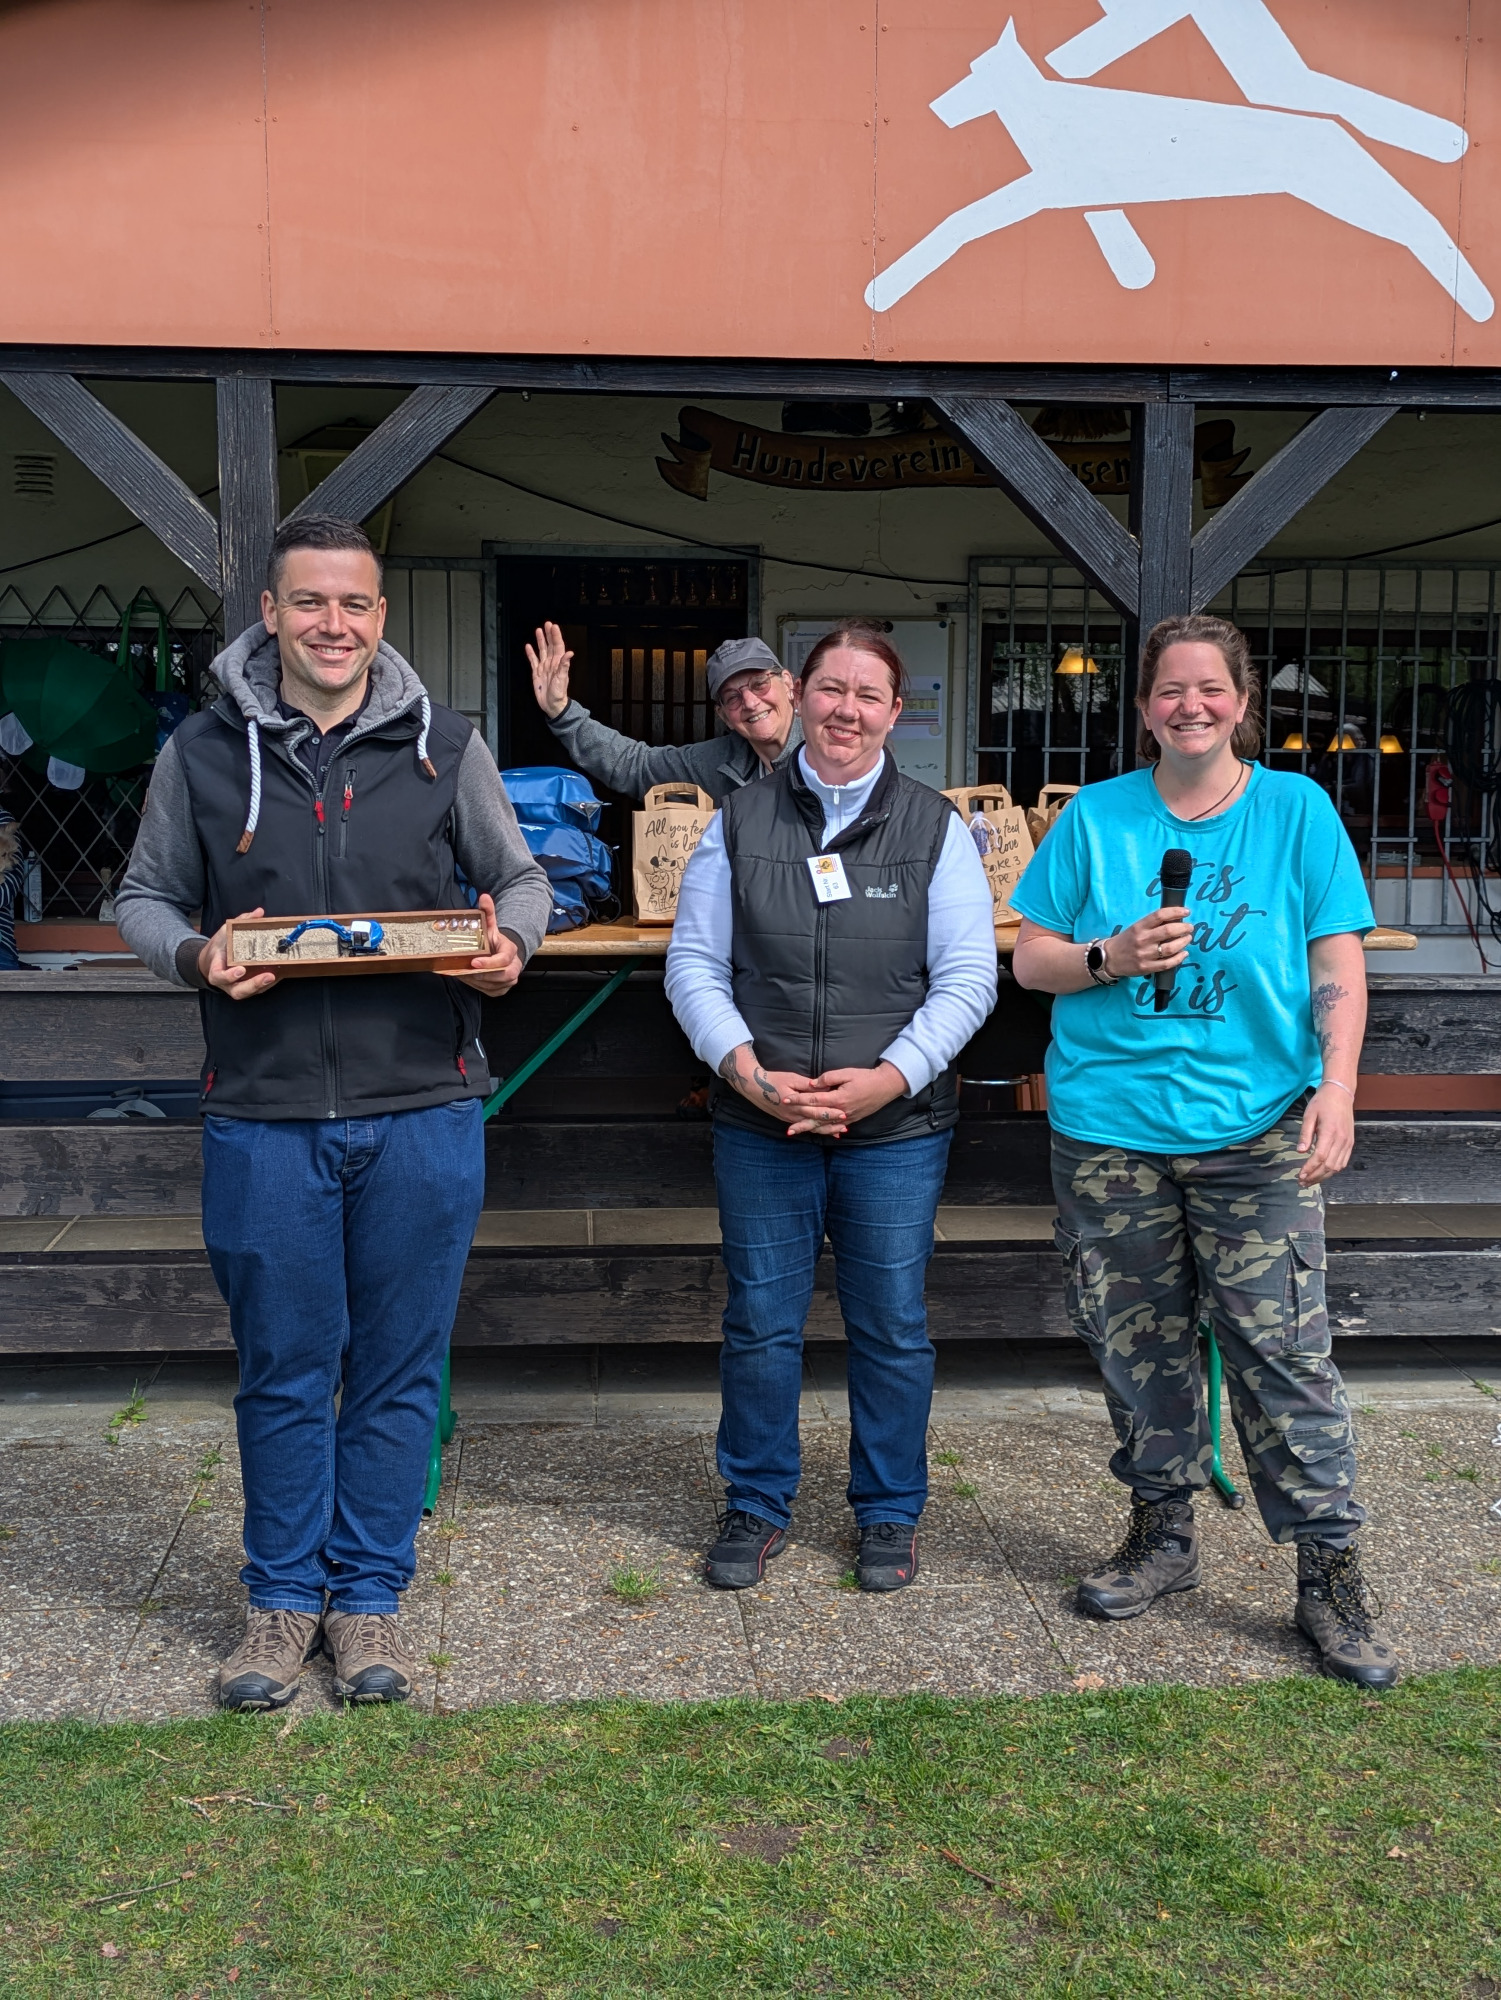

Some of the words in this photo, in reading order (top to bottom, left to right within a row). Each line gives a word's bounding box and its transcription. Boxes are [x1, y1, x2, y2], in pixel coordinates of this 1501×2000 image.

[732, 431, 962, 484] Hundeverein
[645, 817, 667, 838] All
[670, 824, 688, 839] you
[690, 819, 704, 838] fee
[1004, 818, 1020, 838] feed
[670, 840, 679, 849] is
[683, 834, 699, 852] lov
[998, 836, 1019, 854] love
[1195, 865, 1245, 903] is
[1189, 970, 1238, 1014] is
